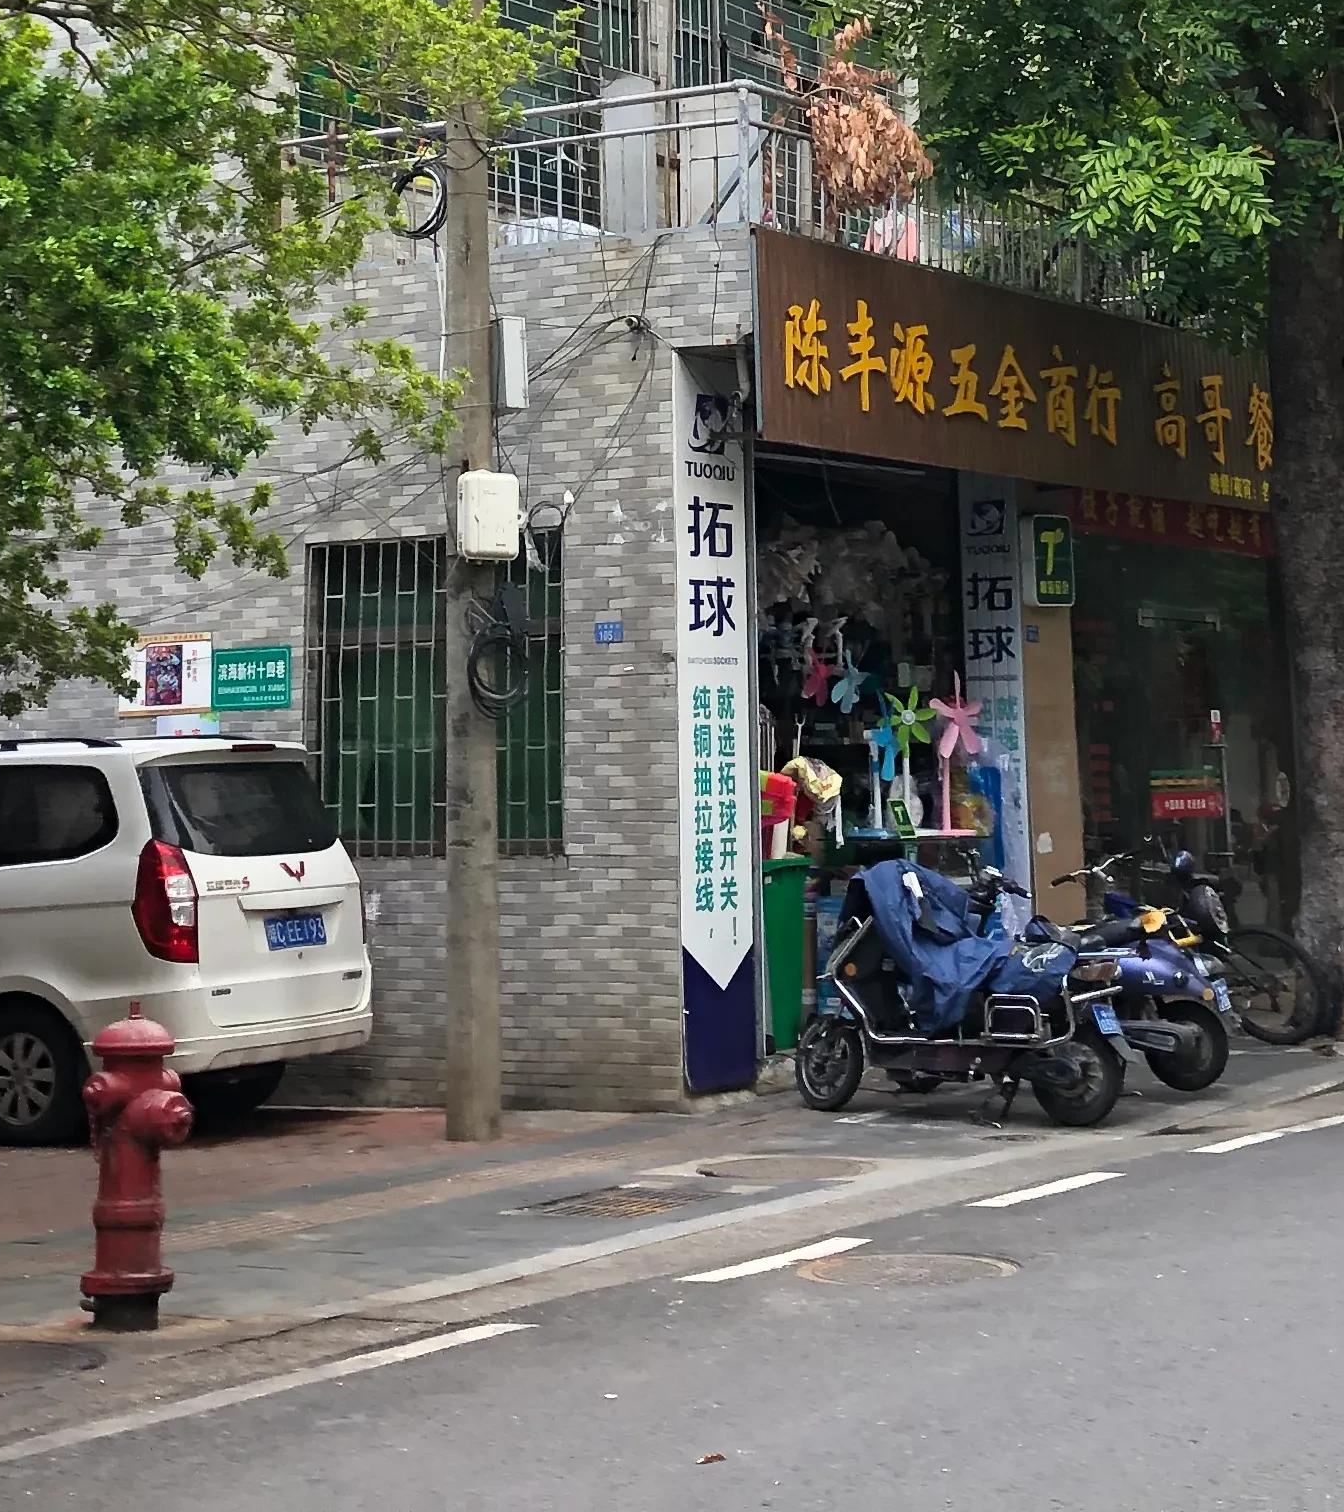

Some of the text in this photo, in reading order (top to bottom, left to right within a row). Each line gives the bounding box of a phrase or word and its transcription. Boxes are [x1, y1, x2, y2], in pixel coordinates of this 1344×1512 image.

[784, 298, 1122, 447] 陈丰源五金商行
[685, 461, 736, 481] TUOQIU
[687, 495, 736, 637] 拓球
[966, 572, 1016, 664] 拓球
[217, 659, 286, 681] 滨海新村十四巷
